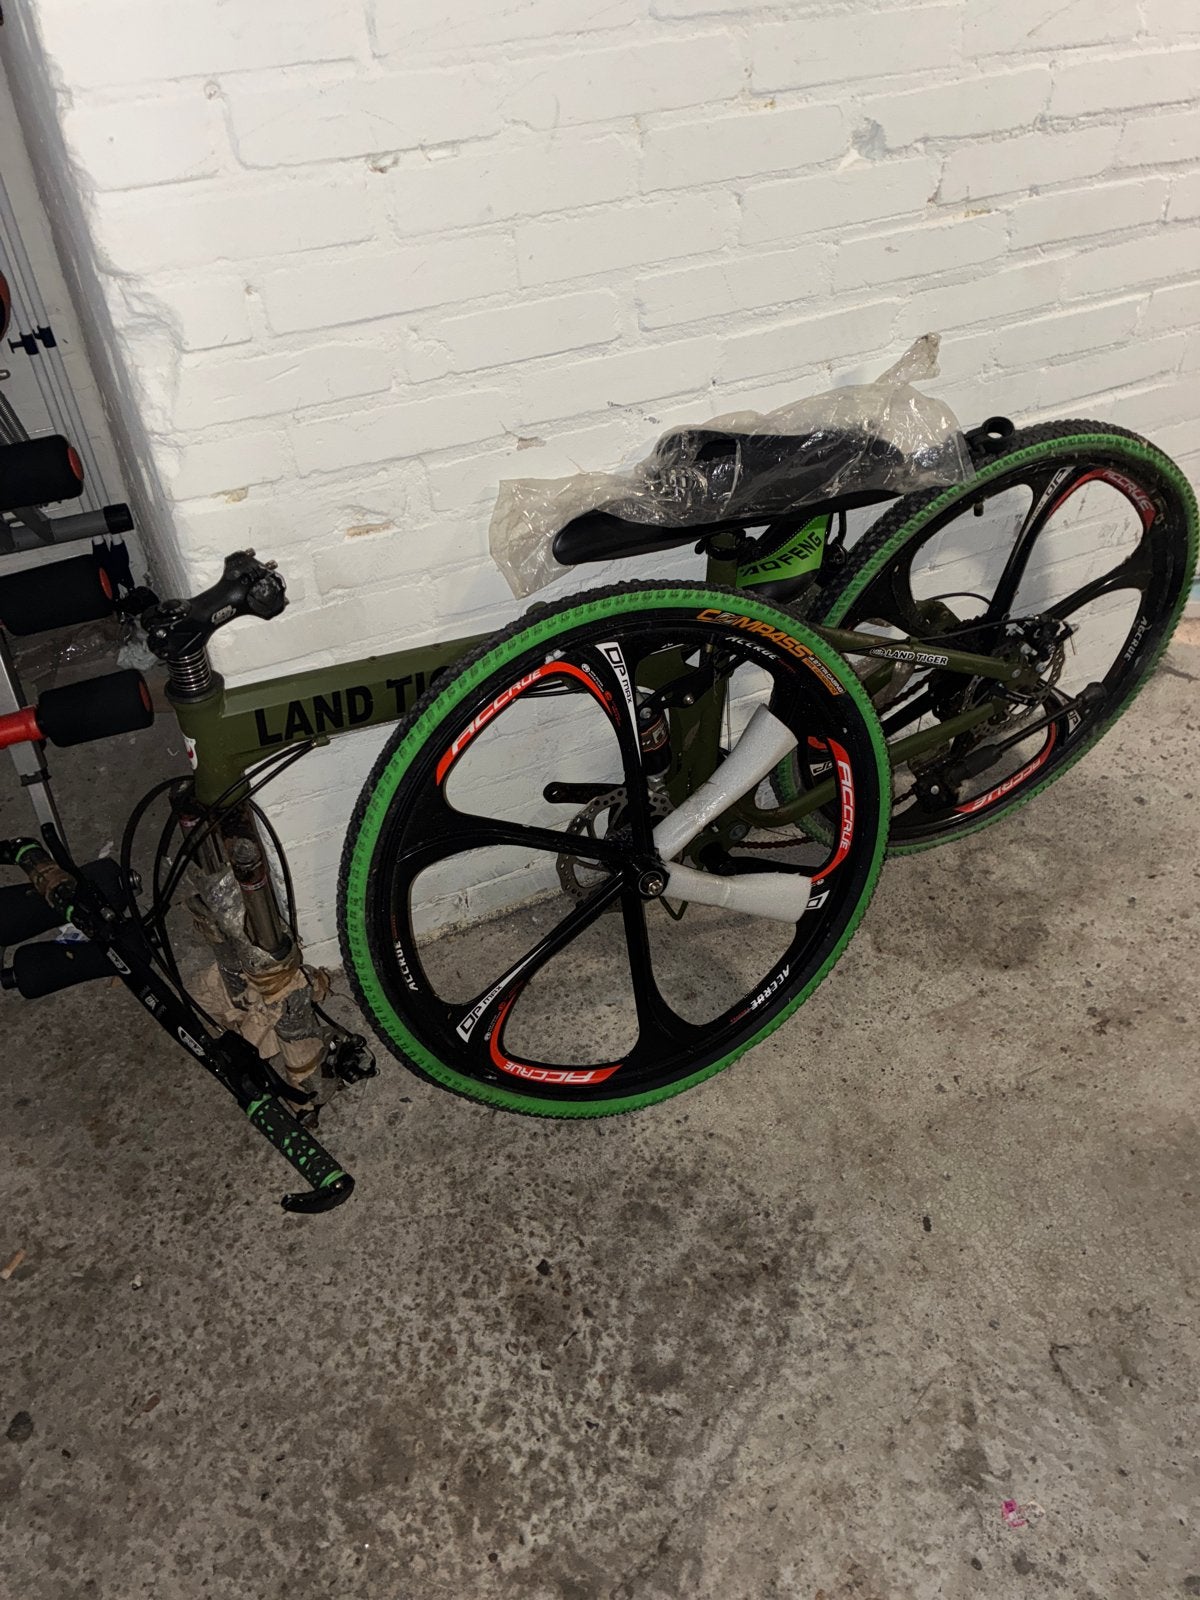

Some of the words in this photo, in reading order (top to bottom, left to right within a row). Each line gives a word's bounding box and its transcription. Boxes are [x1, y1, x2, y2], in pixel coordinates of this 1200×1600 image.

[885, 649, 915, 661] LAND
[917, 653, 948, 665] TIGER
[254, 685, 374, 747] LAND
[450, 668, 542, 756] ACCRUE
[837, 760, 853, 850] ACCRUE
[972, 758, 1042, 810] ACCRUE
[393, 940, 419, 992] ACCRUE
[503, 1060, 599, 1083] ACCRUE
